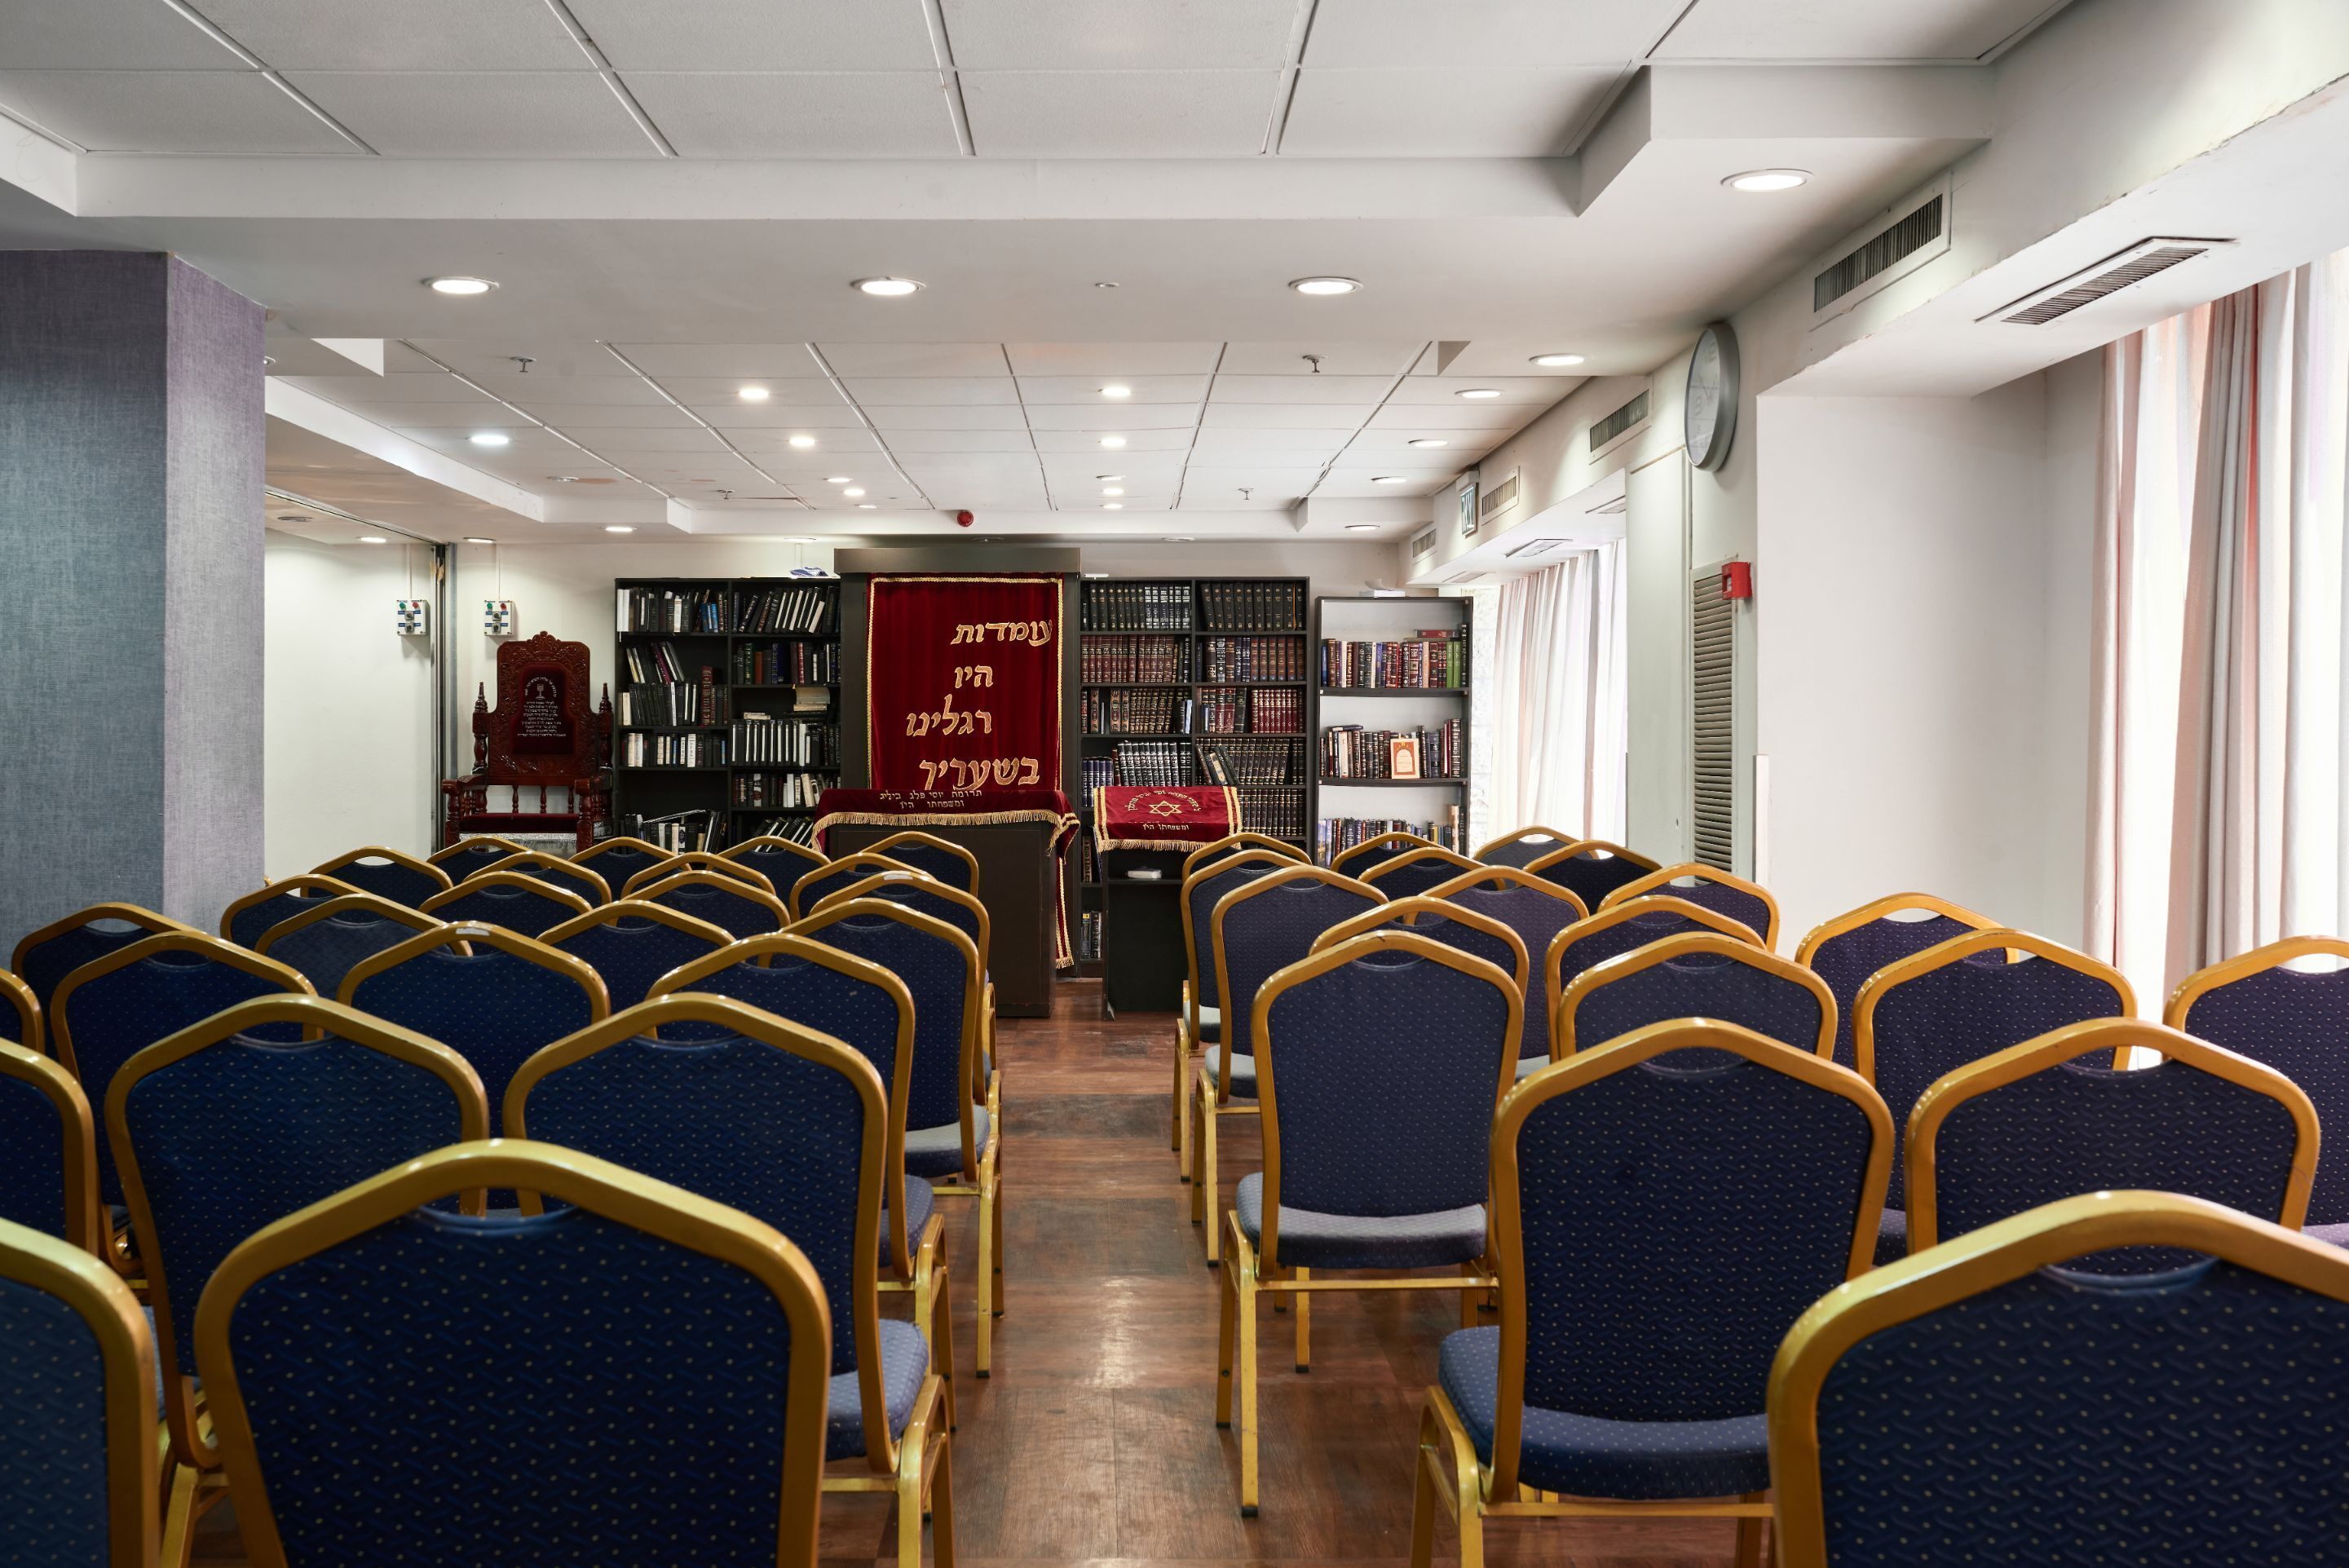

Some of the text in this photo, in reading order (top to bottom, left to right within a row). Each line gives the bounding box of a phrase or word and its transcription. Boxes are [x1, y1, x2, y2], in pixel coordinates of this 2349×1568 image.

[950, 619, 1053, 647] עומדות
[954, 665, 993, 689] היו
[906, 694, 993, 737] רגלינו
[919, 757, 1040, 791] בשעריך
[909, 789, 925, 800] פלג
[926, 800, 965, 808] ומשפחתו
[952, 789, 982, 797] תרומת
